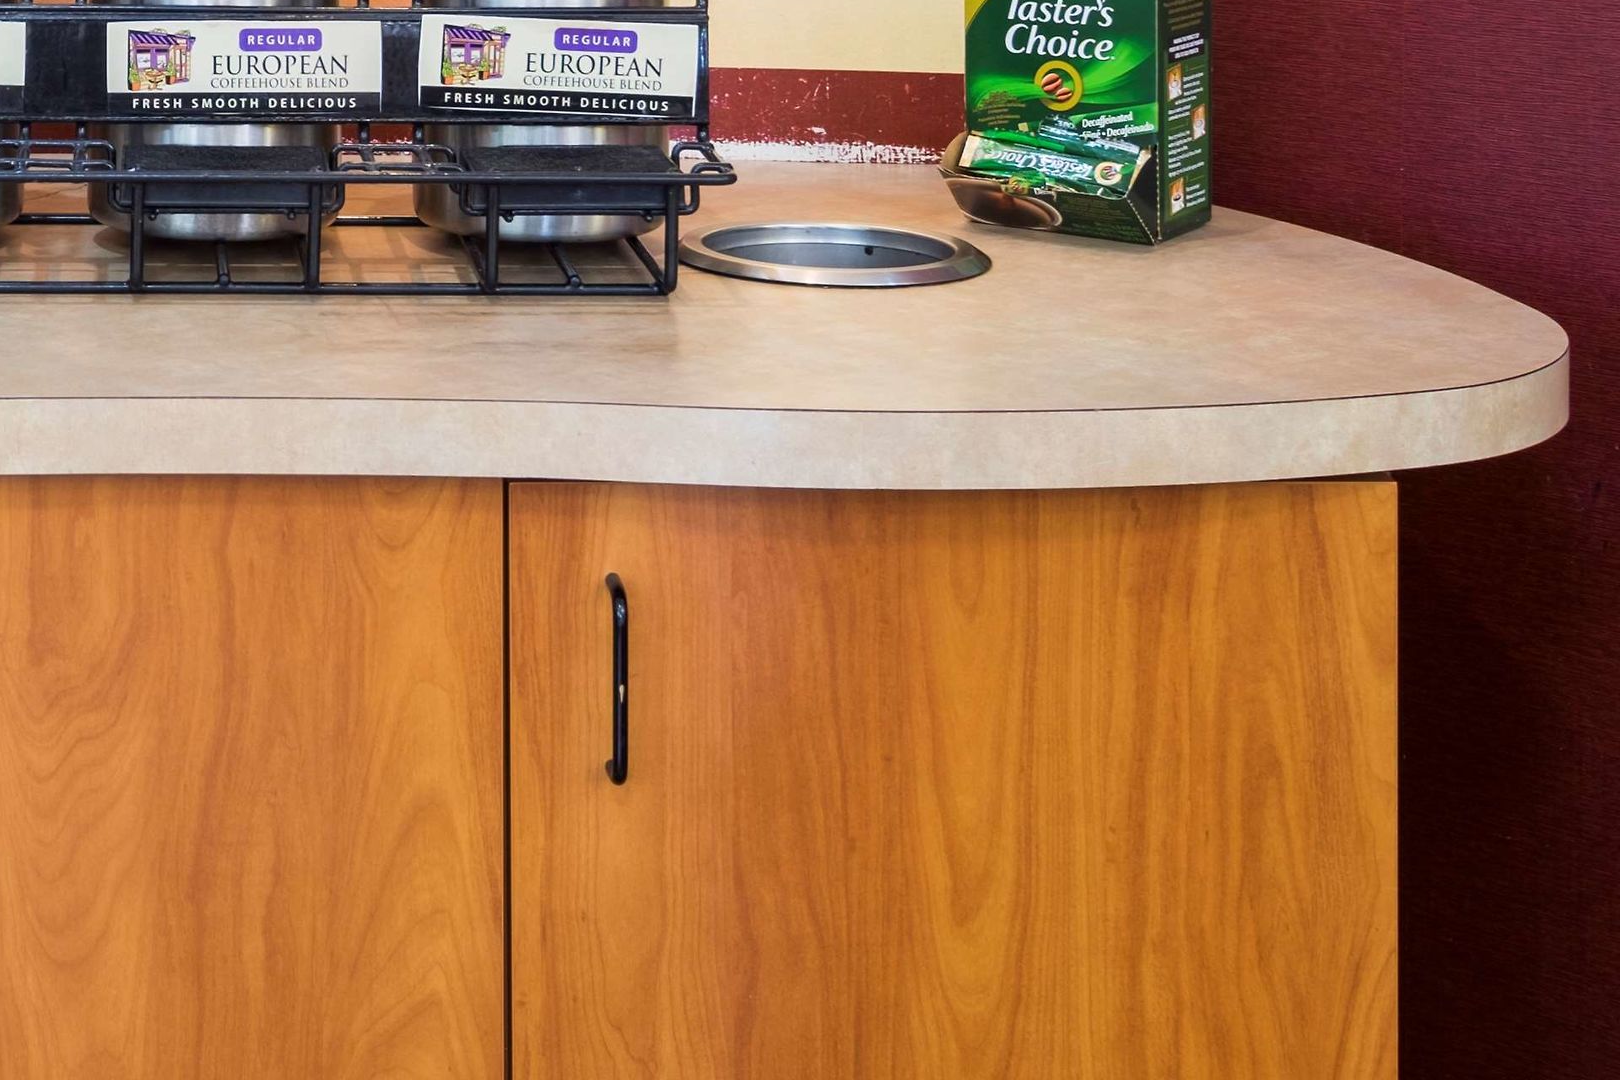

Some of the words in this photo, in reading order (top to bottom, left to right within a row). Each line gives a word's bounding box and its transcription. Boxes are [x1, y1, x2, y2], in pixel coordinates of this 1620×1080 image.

[247, 35, 316, 45] REGULAR
[562, 34, 631, 47] REGULAR
[1005, 23, 1114, 61] Choice
[212, 54, 349, 75] EUROPEAN
[526, 53, 663, 77] EUROPEAN
[210, 77, 302, 89] COFFEEHOUSE
[307, 77, 349, 89] BLEND
[523, 75, 617, 89] COFFEEHOUSE
[619, 79, 662, 91] BLEND
[132, 98, 182, 109] FRESH
[191, 98, 259, 109] SMOOTH
[268, 98, 357, 109] DELICIOUS
[444, 92, 494, 104] FRESH
[503, 94, 571, 107] SMOOTH
[580, 97, 669, 111] DELICIOUS
